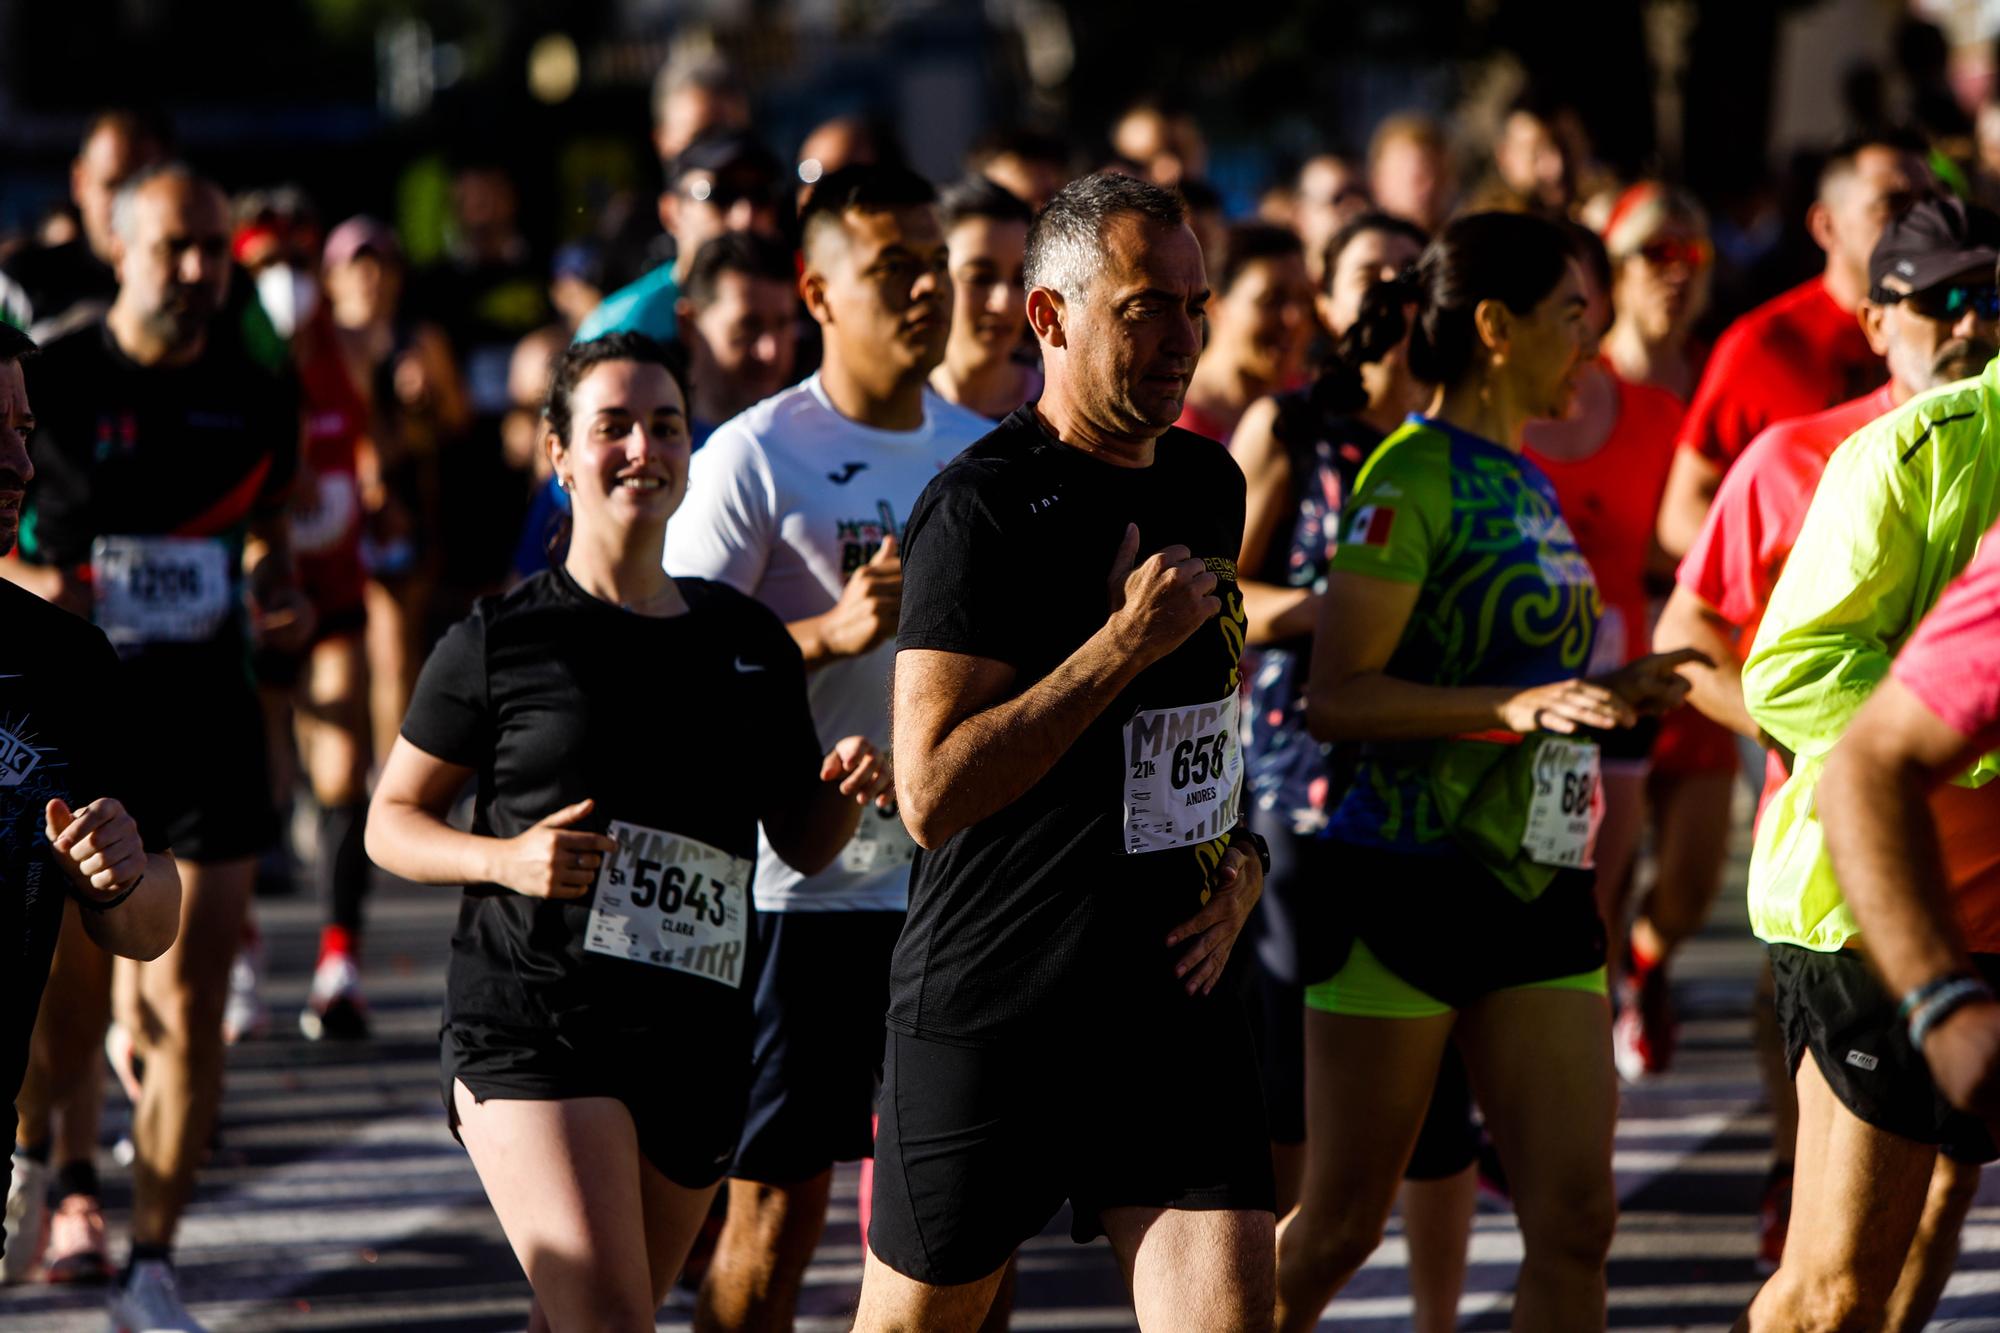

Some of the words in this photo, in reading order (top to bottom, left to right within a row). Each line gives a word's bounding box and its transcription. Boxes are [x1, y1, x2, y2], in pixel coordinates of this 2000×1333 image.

[1171, 729, 1229, 790] 658
[1185, 786, 1217, 807] ANDRES
[630, 858, 726, 928] 5643
[661, 917, 696, 938] CLARA
